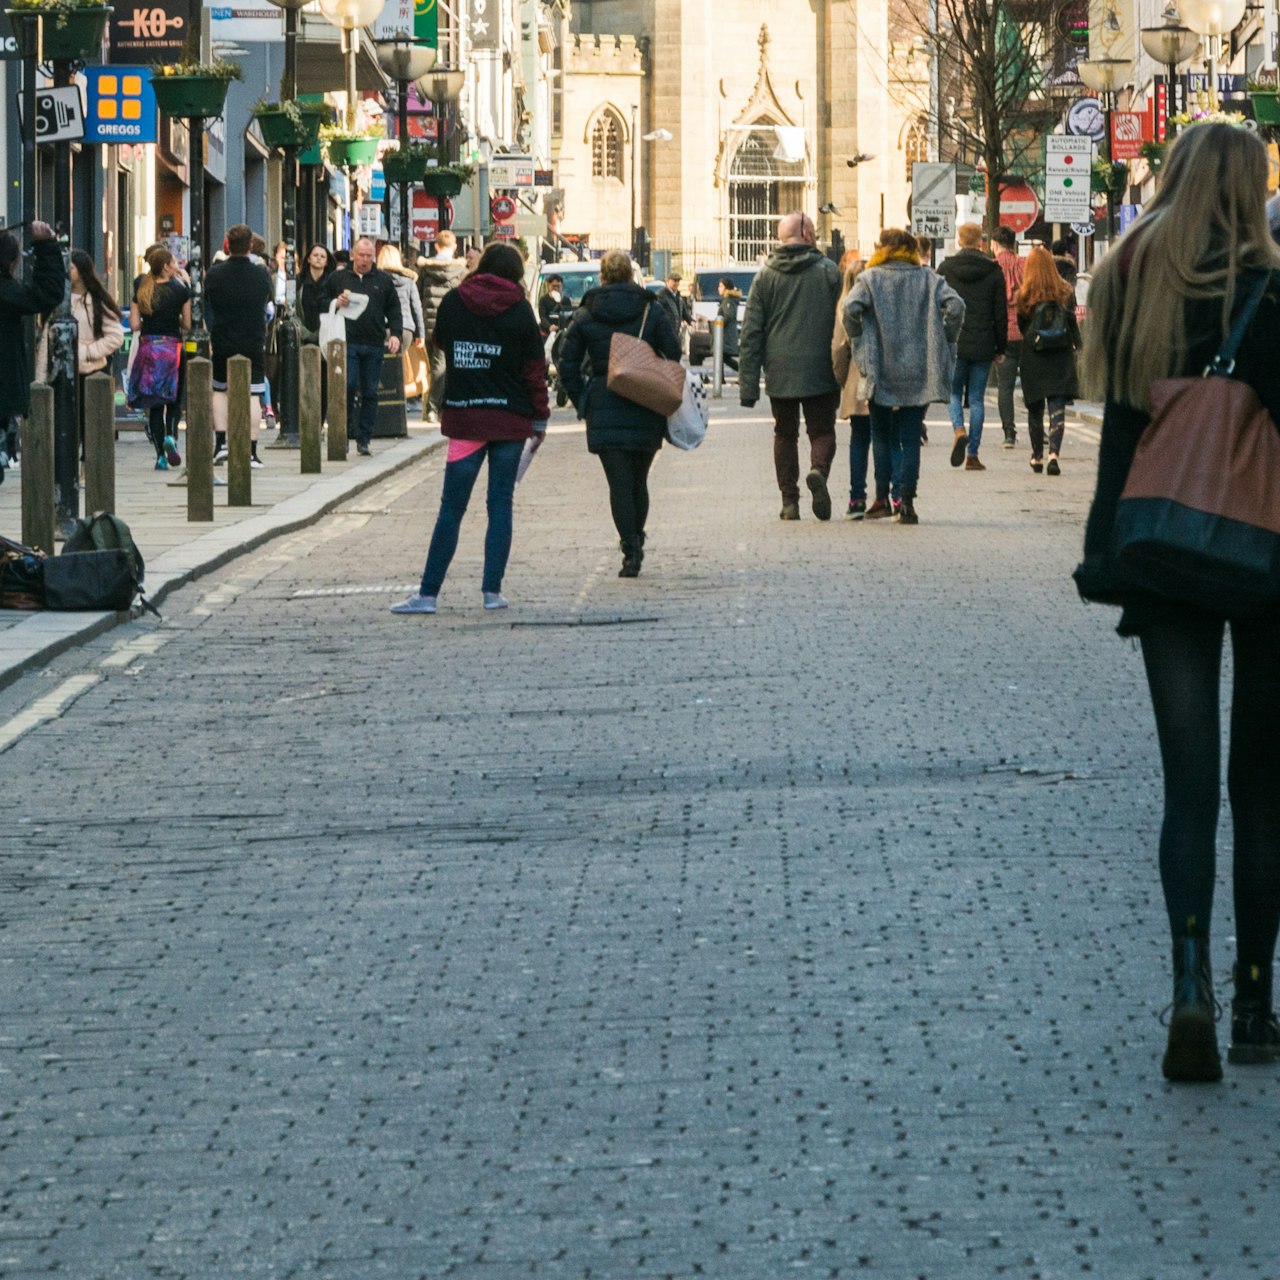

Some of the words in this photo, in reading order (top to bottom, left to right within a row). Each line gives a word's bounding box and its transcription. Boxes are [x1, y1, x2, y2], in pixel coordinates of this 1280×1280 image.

[235, 9, 280, 19] WAREHOUSE
[132, 7, 167, 39] KO
[97, 123, 141, 136] GREGGS
[914, 208, 953, 216] Pedestrian
[916, 223, 950, 234] ENDS
[454, 342, 501, 355] PROTECT
[454, 351, 474, 359] THE
[454, 359, 490, 368] HUMAN
